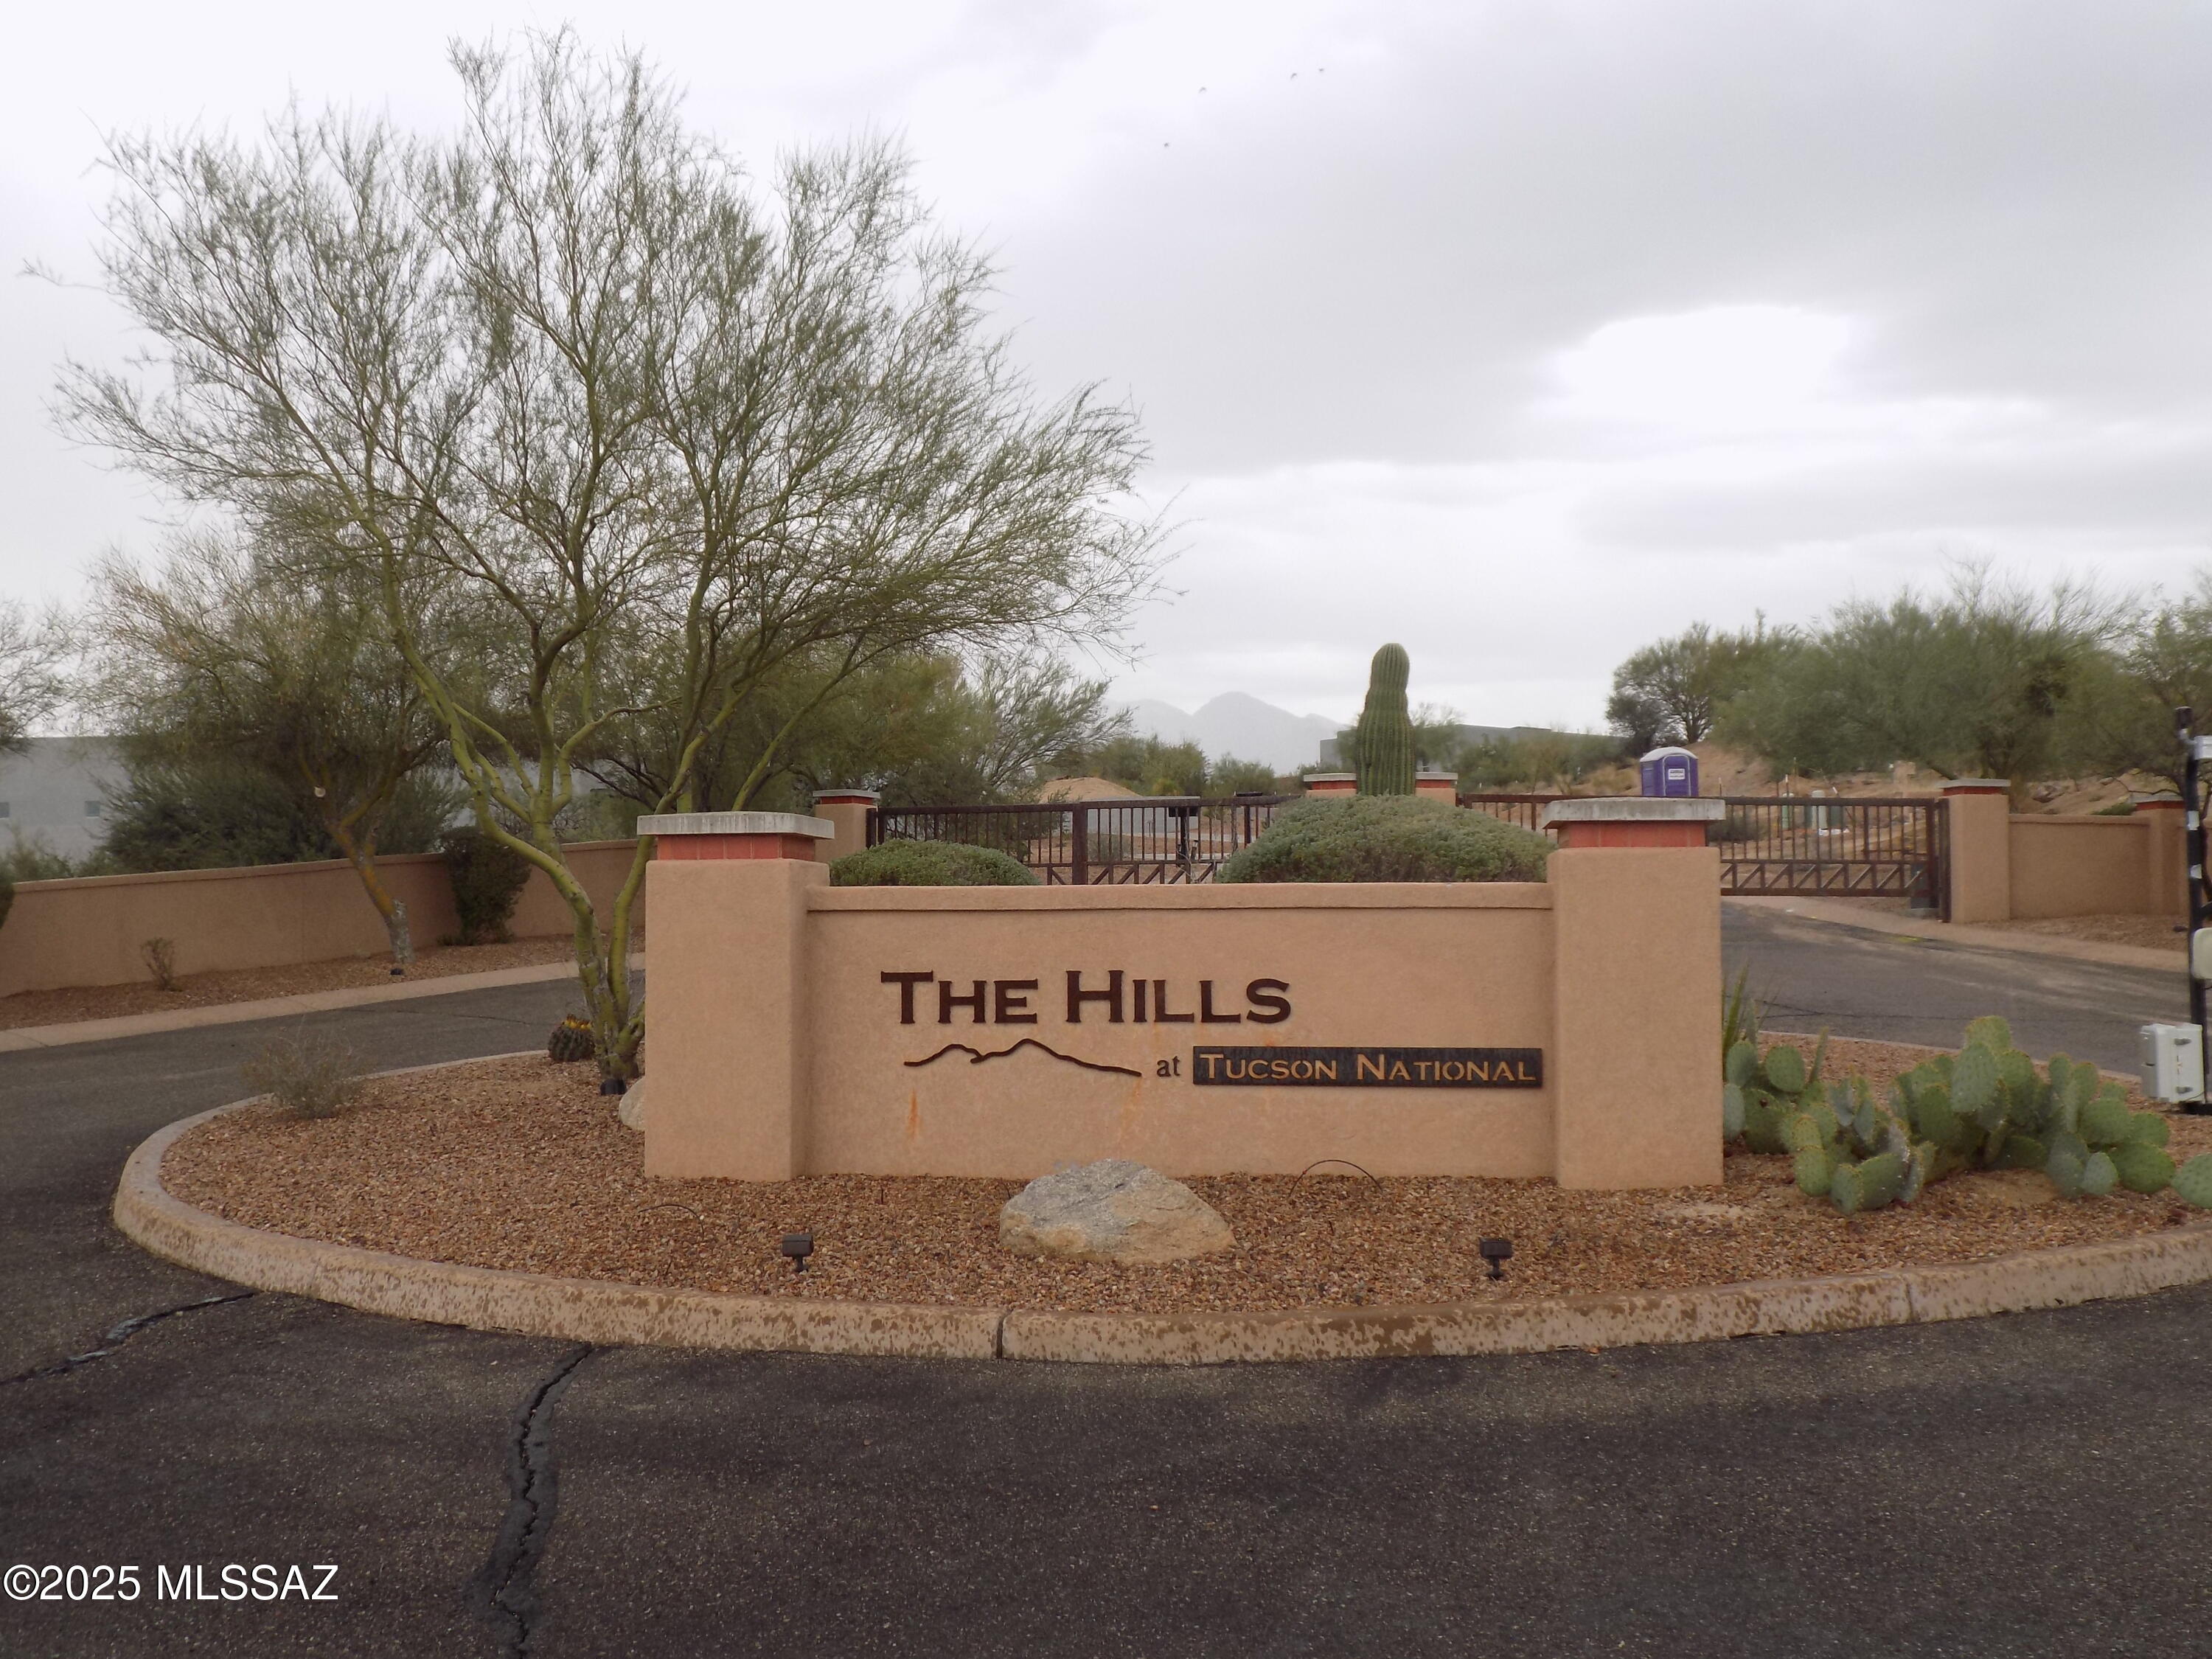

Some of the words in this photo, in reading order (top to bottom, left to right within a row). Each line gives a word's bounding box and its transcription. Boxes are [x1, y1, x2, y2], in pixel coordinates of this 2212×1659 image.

[880, 970, 1038, 1024] THE
[1065, 970, 1292, 1023] HILLS
[1157, 1053, 1181, 1079] at
[1199, 1052, 1338, 1081] TUCSON
[1356, 1053, 1537, 1082] NATIONAL
